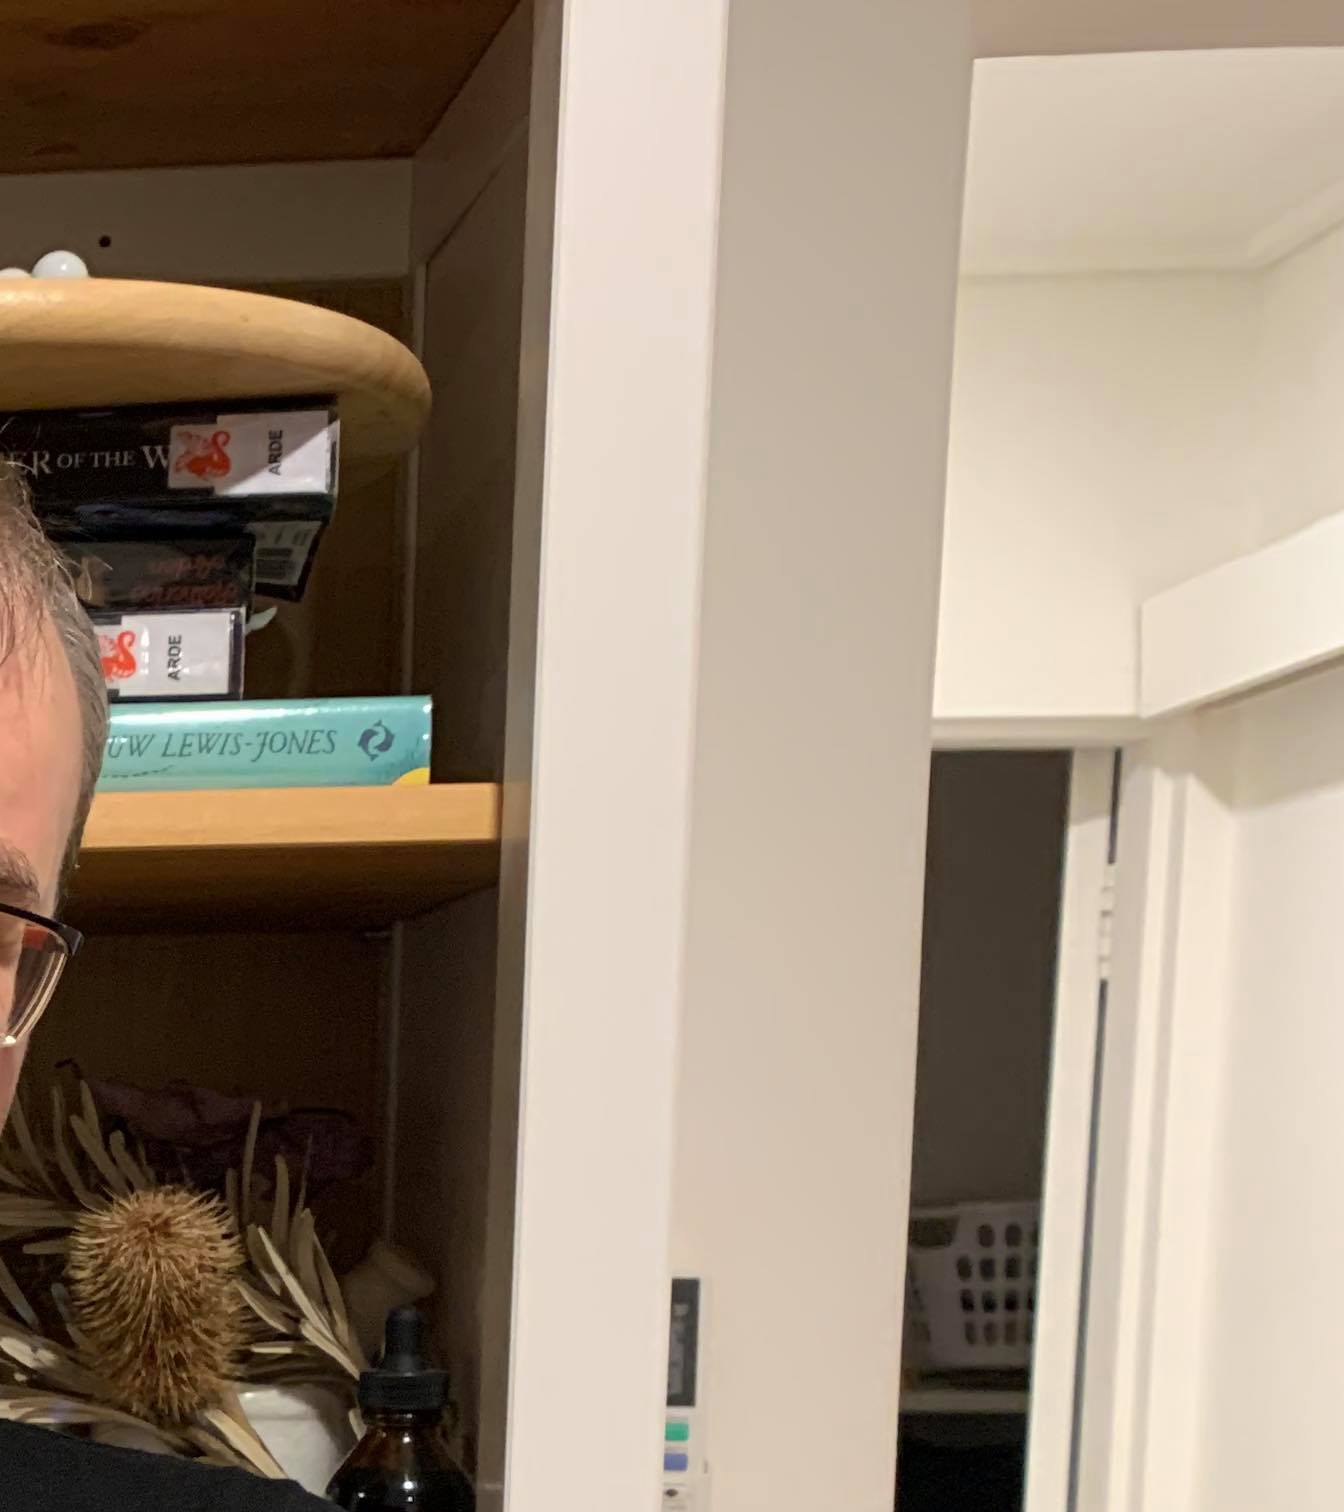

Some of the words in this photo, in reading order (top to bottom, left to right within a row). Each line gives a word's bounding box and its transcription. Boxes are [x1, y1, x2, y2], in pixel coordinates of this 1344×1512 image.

[55, 452, 84, 469] OF
[88, 451, 135, 468] THE
[268, 429, 283, 476] ARDE
[167, 634, 182, 682] ARDE
[161, 729, 338, 763] LEWIS-JONES
